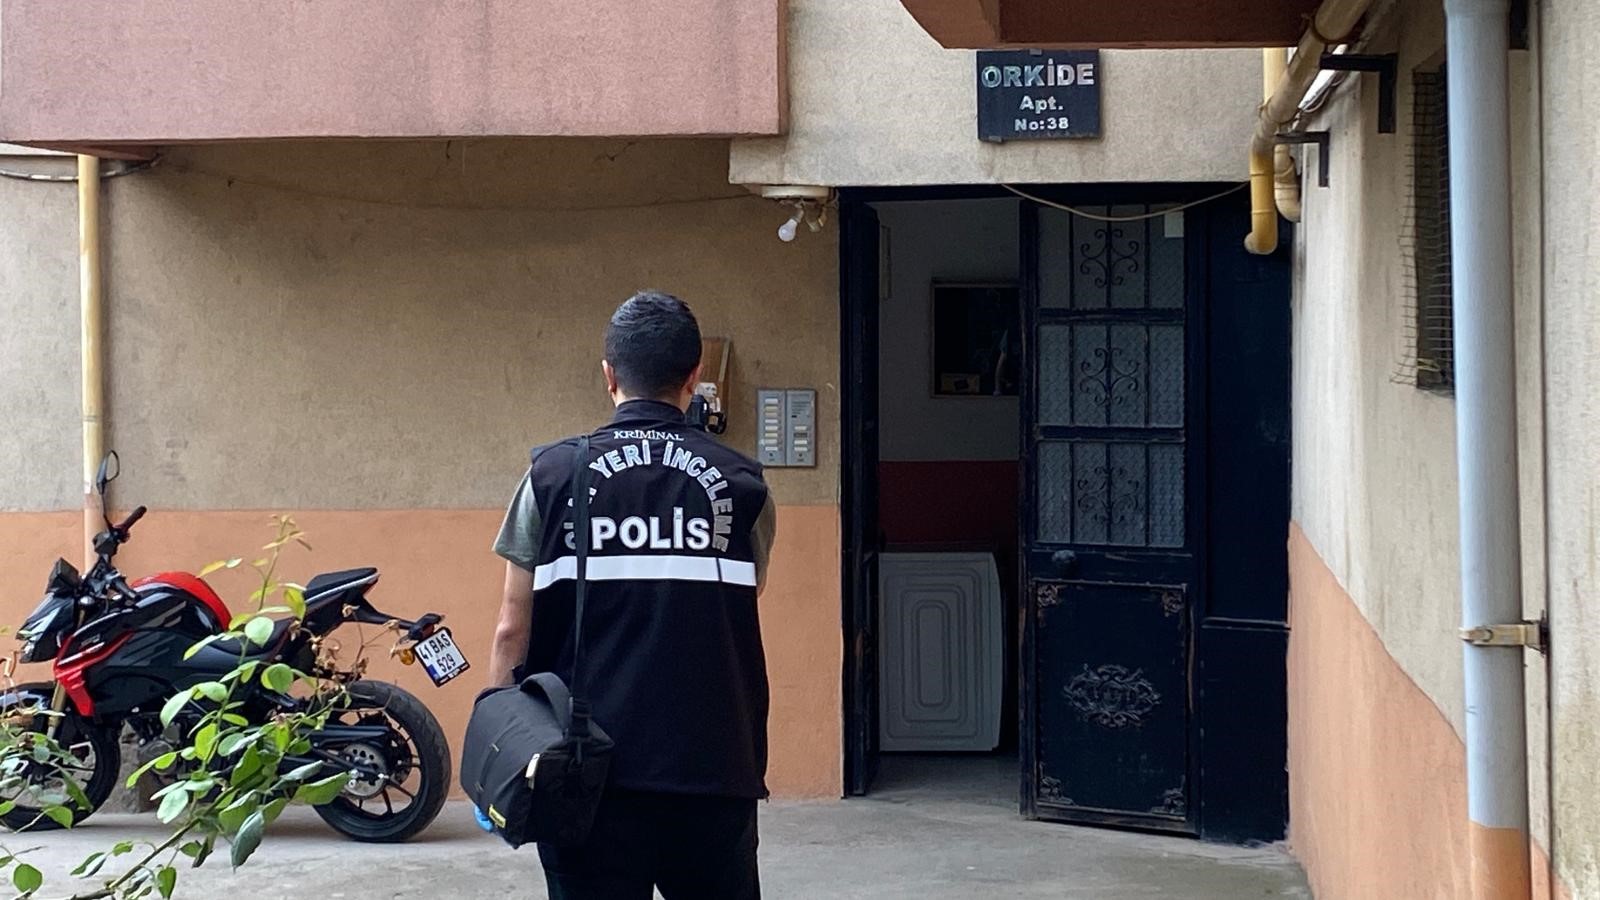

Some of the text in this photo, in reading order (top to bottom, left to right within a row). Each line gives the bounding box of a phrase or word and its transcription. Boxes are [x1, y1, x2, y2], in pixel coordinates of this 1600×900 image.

[981, 58, 1095, 88] ORKİDE
[1020, 95, 1064, 114] Apt.
[1014, 117, 1069, 131] No:38
[589, 439, 651, 479] YERİ
[591, 506, 710, 550] POLİS
[418, 633, 451, 660] 41 BAS
[436, 653, 456, 673] 529
